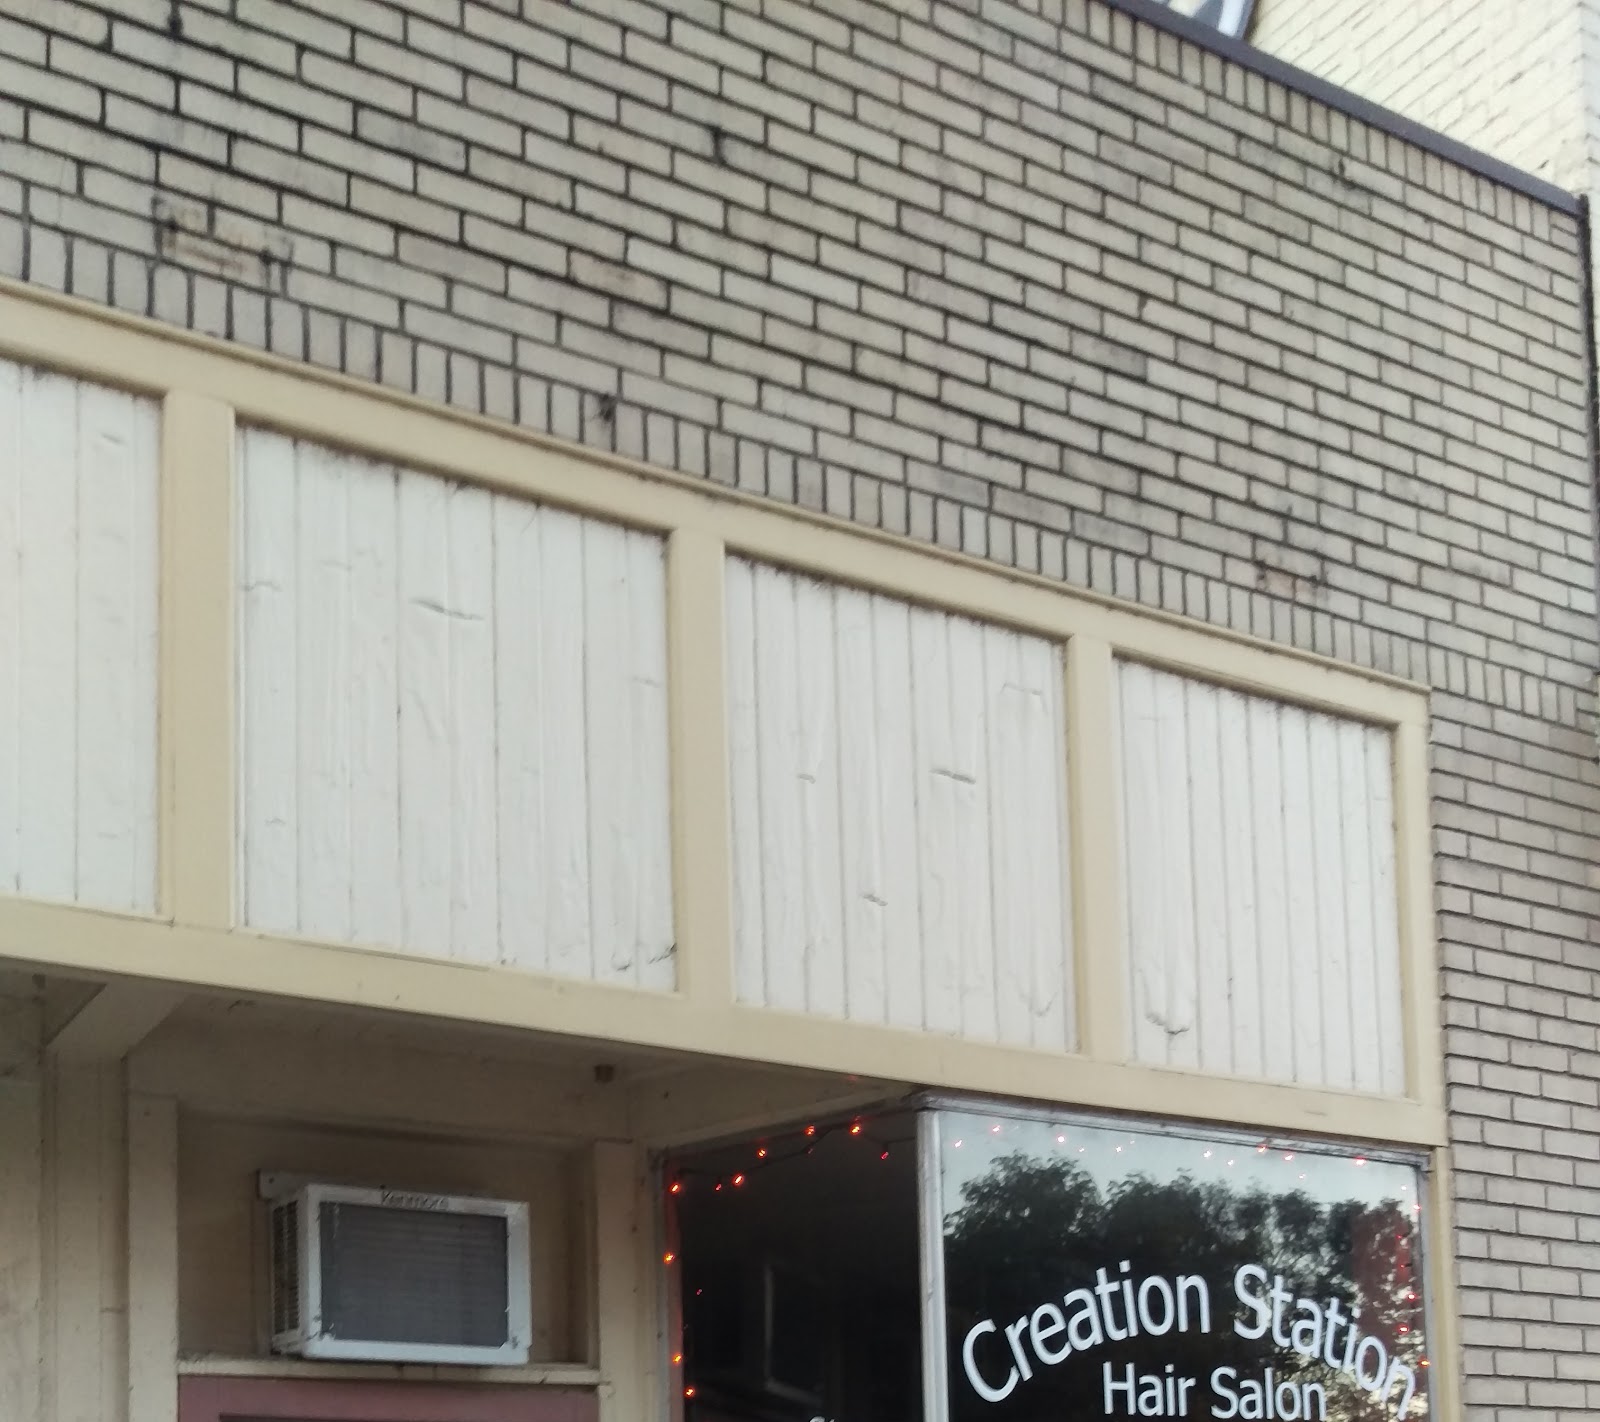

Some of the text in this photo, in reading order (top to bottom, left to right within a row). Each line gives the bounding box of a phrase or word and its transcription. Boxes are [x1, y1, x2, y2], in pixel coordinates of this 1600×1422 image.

[962, 1260, 1417, 1420] Creation Station
[1102, 1361, 1328, 1422] Hair Salon
